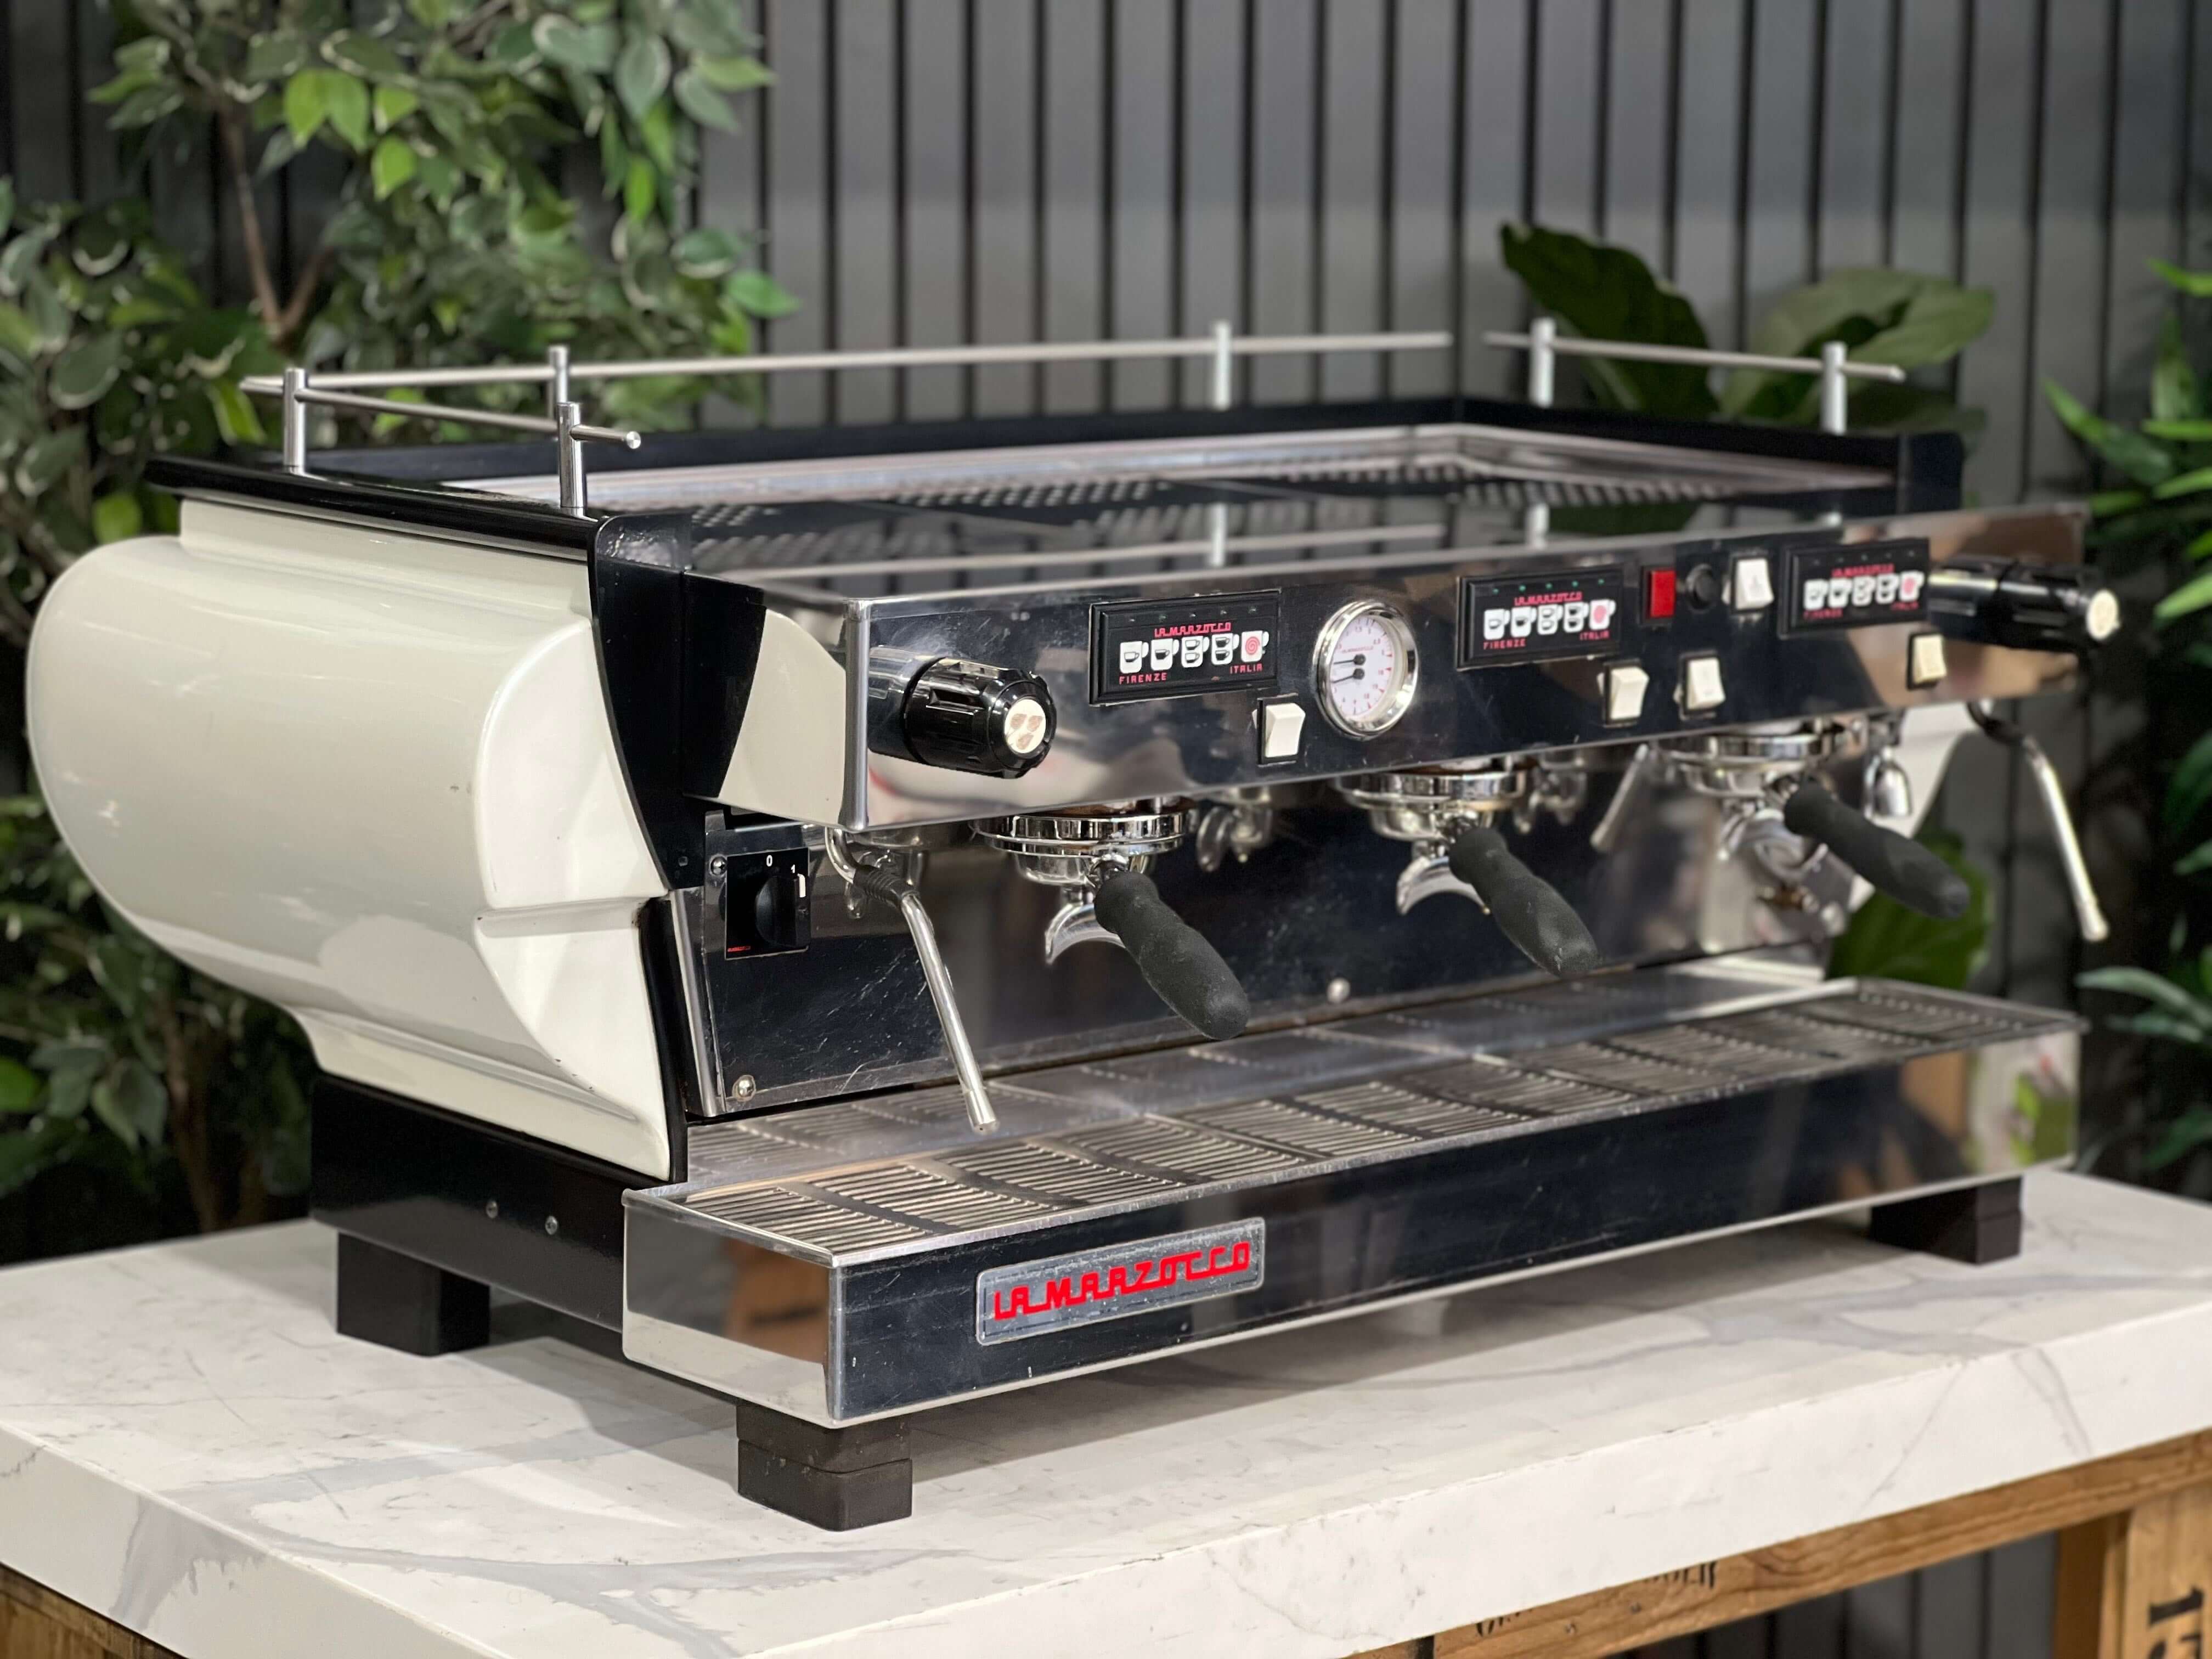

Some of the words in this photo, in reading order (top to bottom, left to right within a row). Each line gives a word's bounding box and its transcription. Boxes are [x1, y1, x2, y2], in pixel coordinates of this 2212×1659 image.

[1154, 627, 1166, 638] LA
[1170, 622, 1232, 636] MARZOCCO
[1229, 663, 1263, 674] ITALIA
[1119, 672, 1167, 685] FIRENZE
[994, 1285, 1029, 1321] LA
[1046, 1241, 1250, 1308] MARZOCCO
